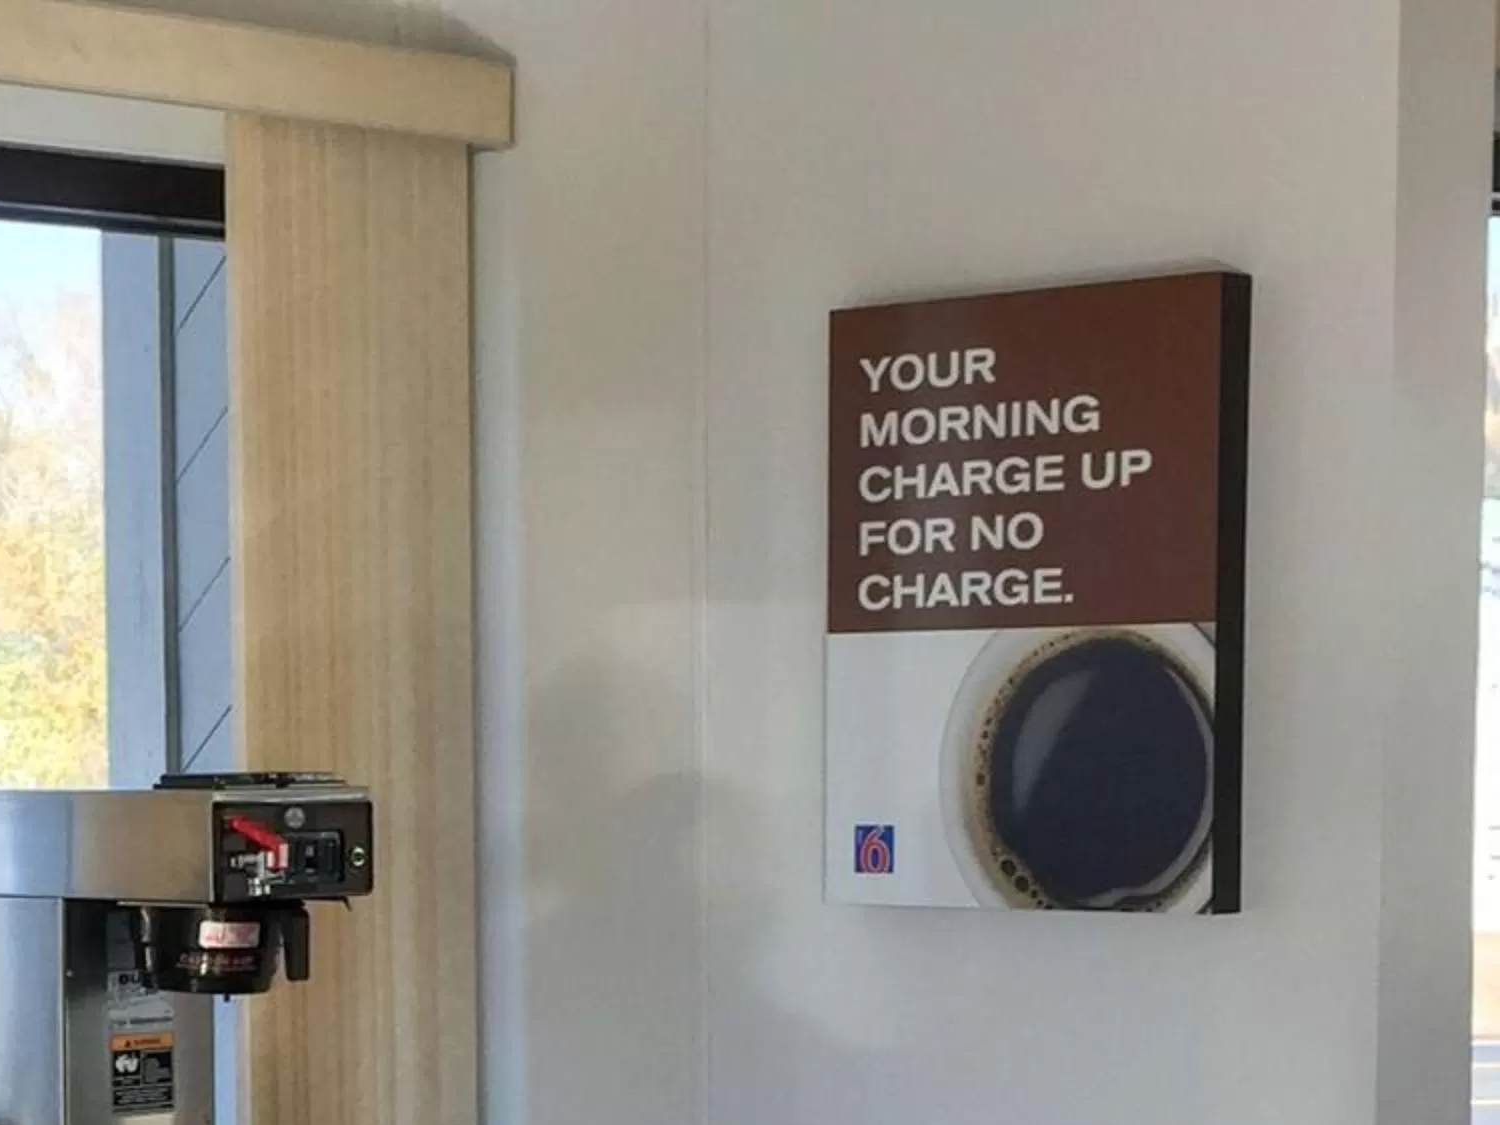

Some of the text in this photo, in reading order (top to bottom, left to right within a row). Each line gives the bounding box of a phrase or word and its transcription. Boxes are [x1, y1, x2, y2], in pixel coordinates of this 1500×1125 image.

[859, 348, 996, 393] YOUR
[860, 395, 1100, 448] MORNING
[859, 449, 1152, 503] CHARGE UP
[859, 512, 1044, 556] FOR NO
[857, 568, 1074, 611] CHARGE.
[860, 825, 890, 875] 6
